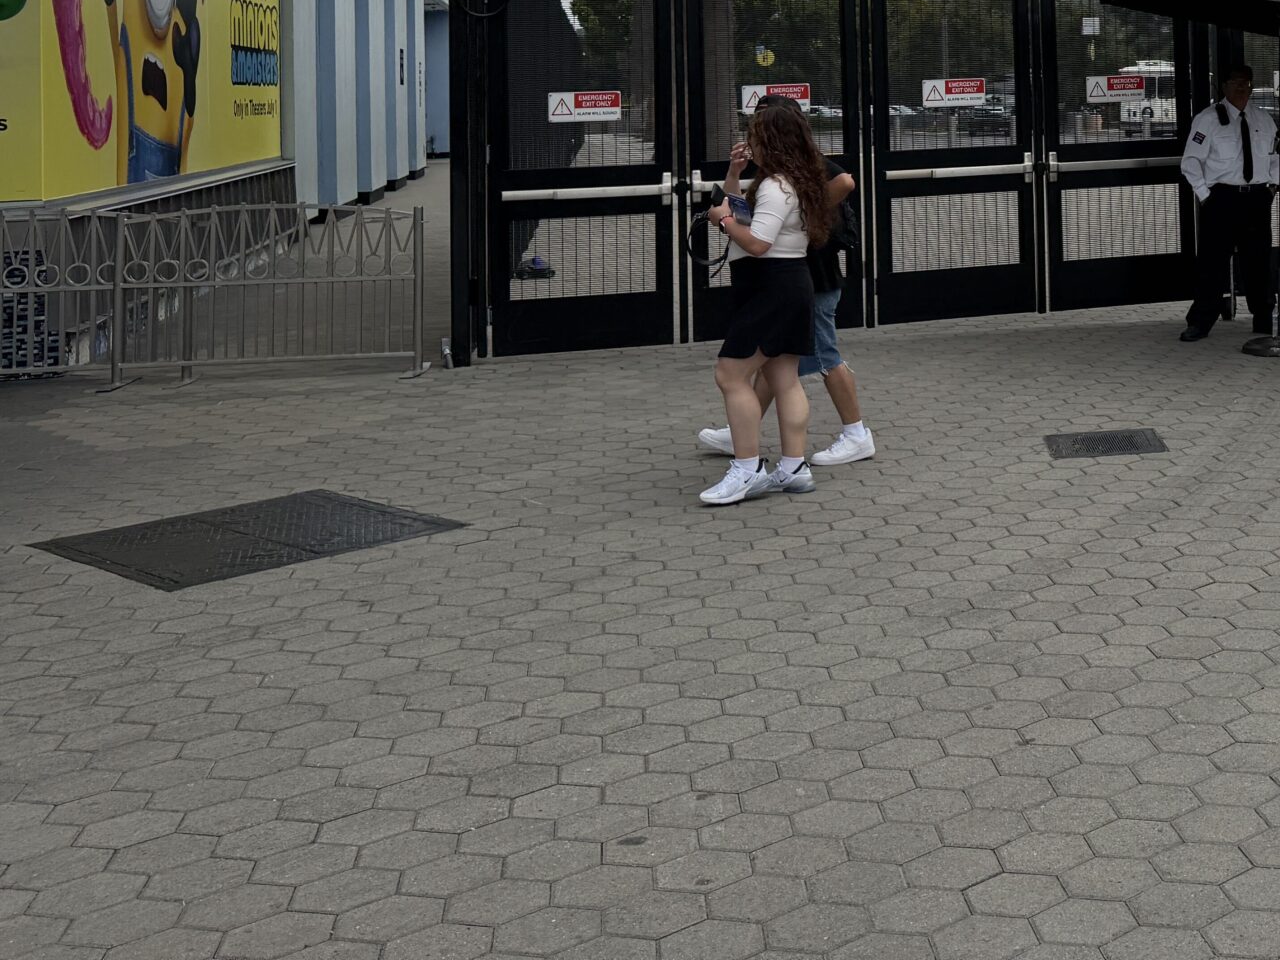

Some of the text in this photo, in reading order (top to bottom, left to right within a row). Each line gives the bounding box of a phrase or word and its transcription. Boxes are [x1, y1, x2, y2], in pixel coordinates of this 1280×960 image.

[233, 99, 243, 120] Only
[244, 99, 249, 116] in
[249, 99, 266, 117] Theaters
[266, 98, 274, 118] July
